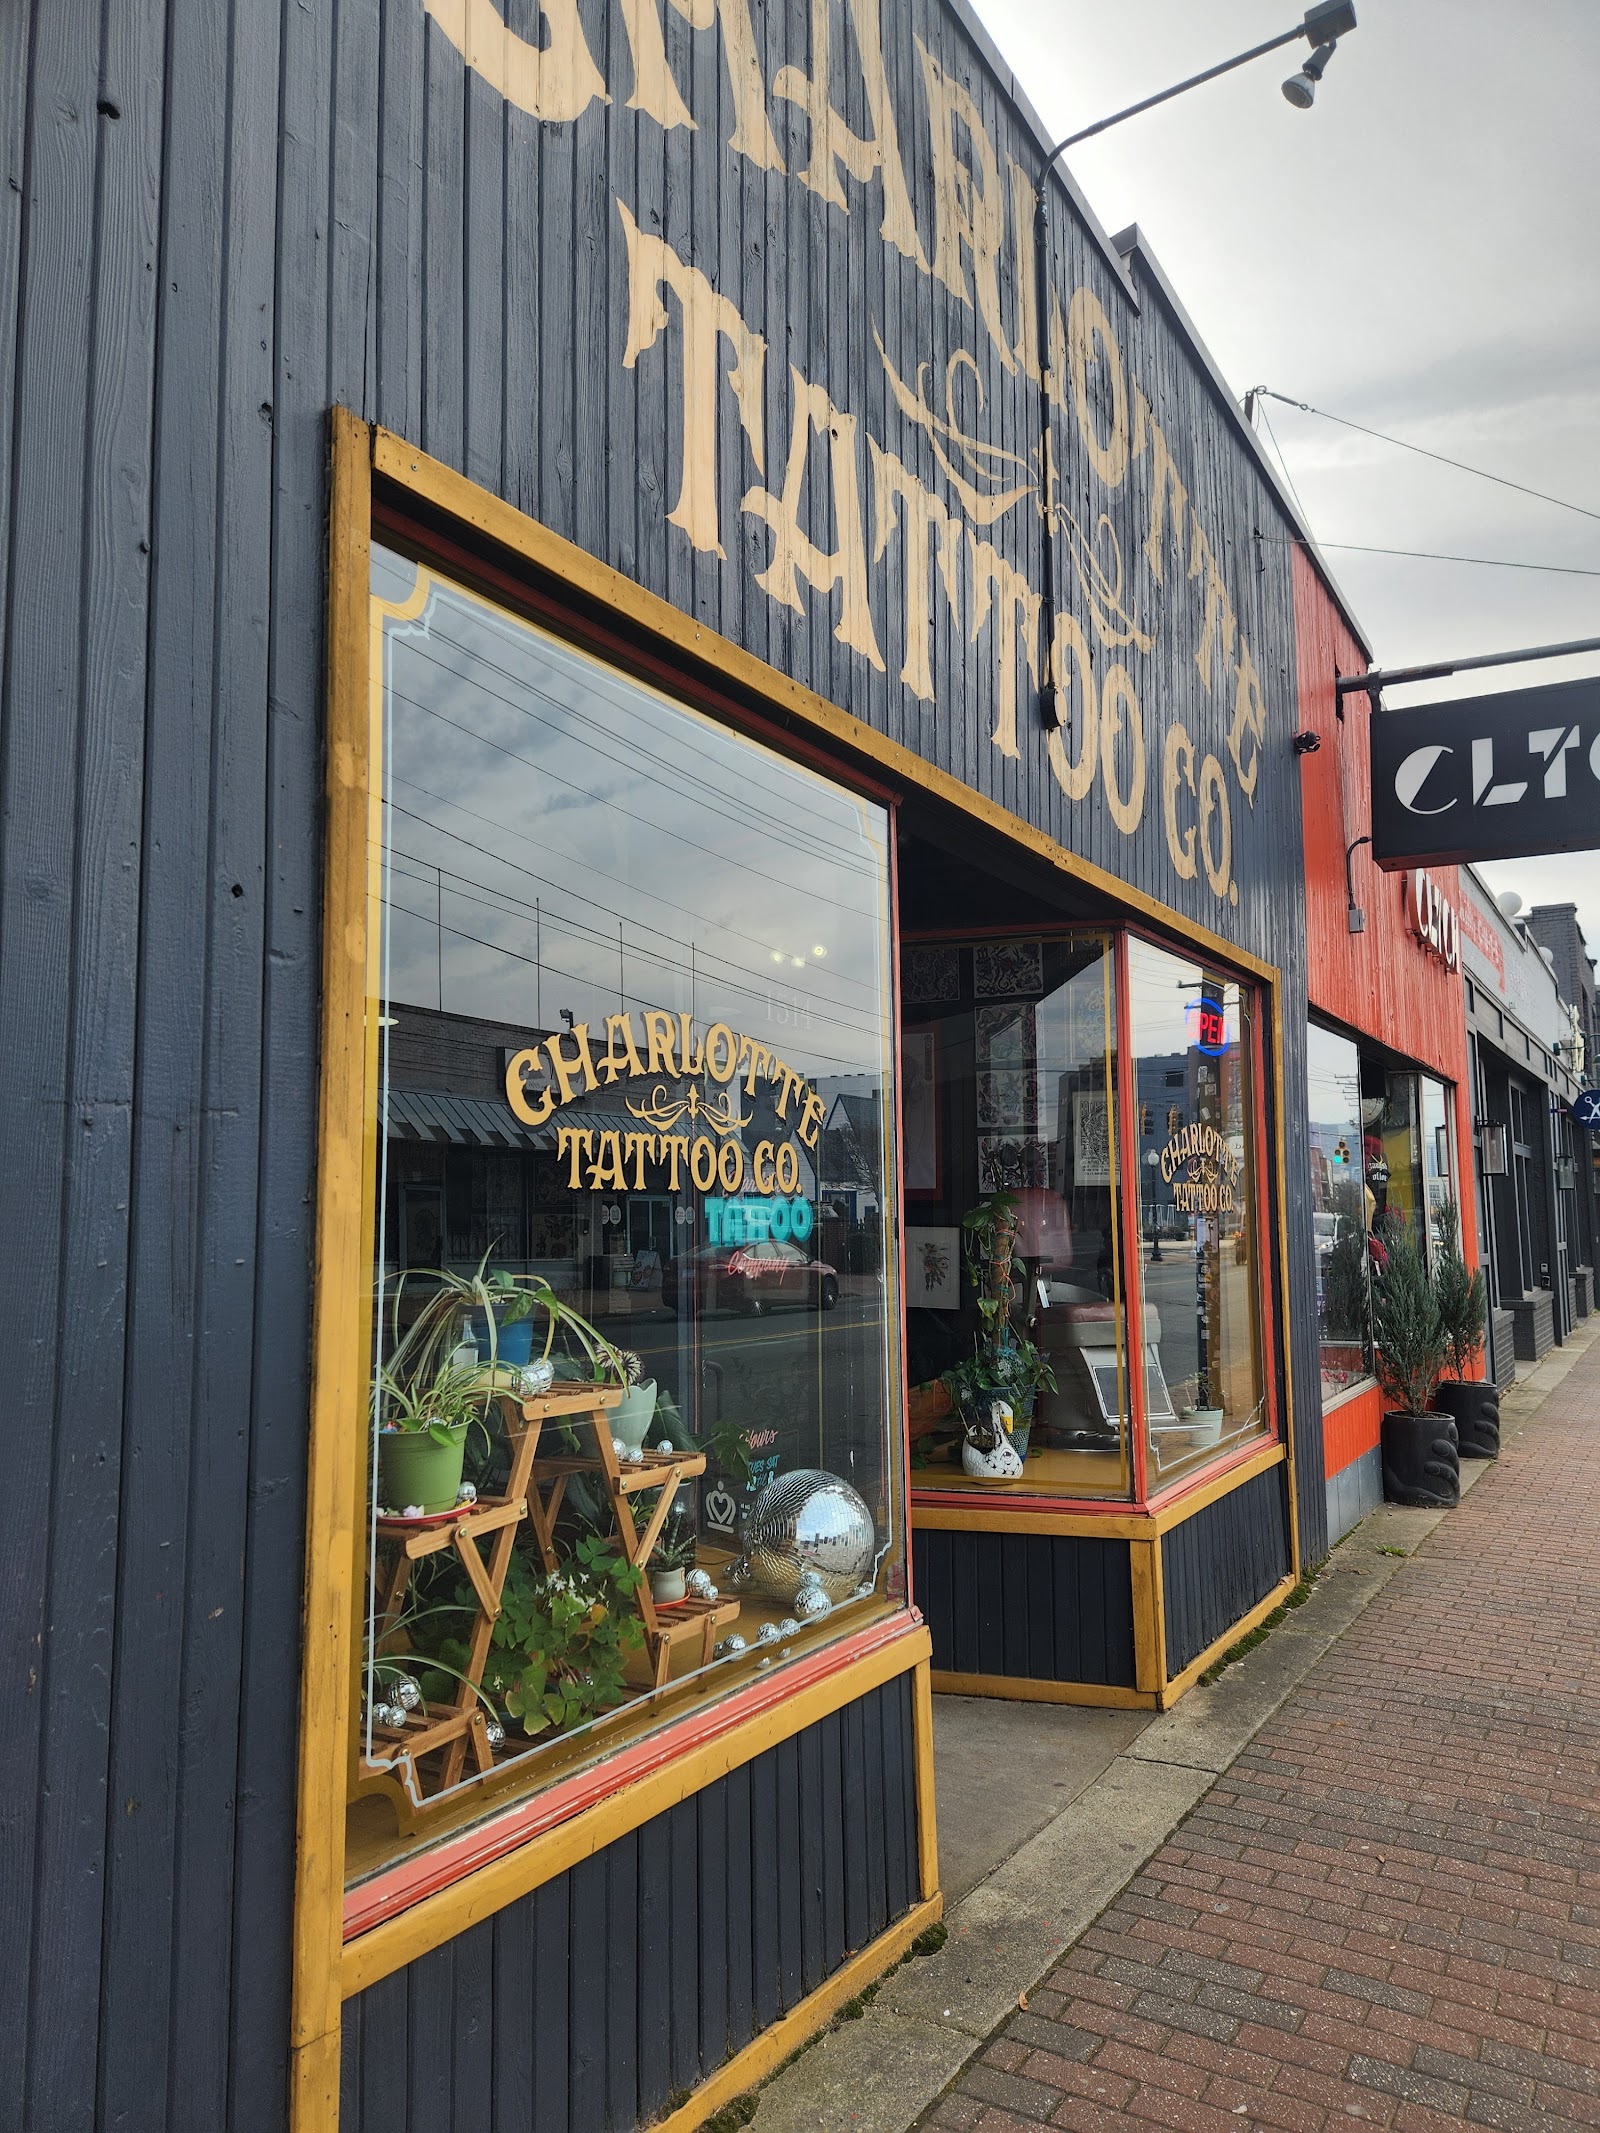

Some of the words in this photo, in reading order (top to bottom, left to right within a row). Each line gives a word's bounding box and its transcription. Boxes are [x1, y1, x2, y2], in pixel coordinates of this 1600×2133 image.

[616, 197, 1145, 835] TATTOO
[1163, 722, 1239, 907] CO.
[1394, 724, 1600, 815] CLT
[1187, 1010, 1227, 1046] OPEN
[505, 1009, 828, 1150] CHARLOTTE
[556, 1126, 744, 1193] TATTOO
[753, 1140, 803, 1195] CO.
[1160, 1122, 1239, 1188] CHARLOTTE
[1172, 1182, 1218, 1212] TATTOO
[1219, 1183, 1234, 1213] CO.
[727, 1250, 791, 1286] Company
